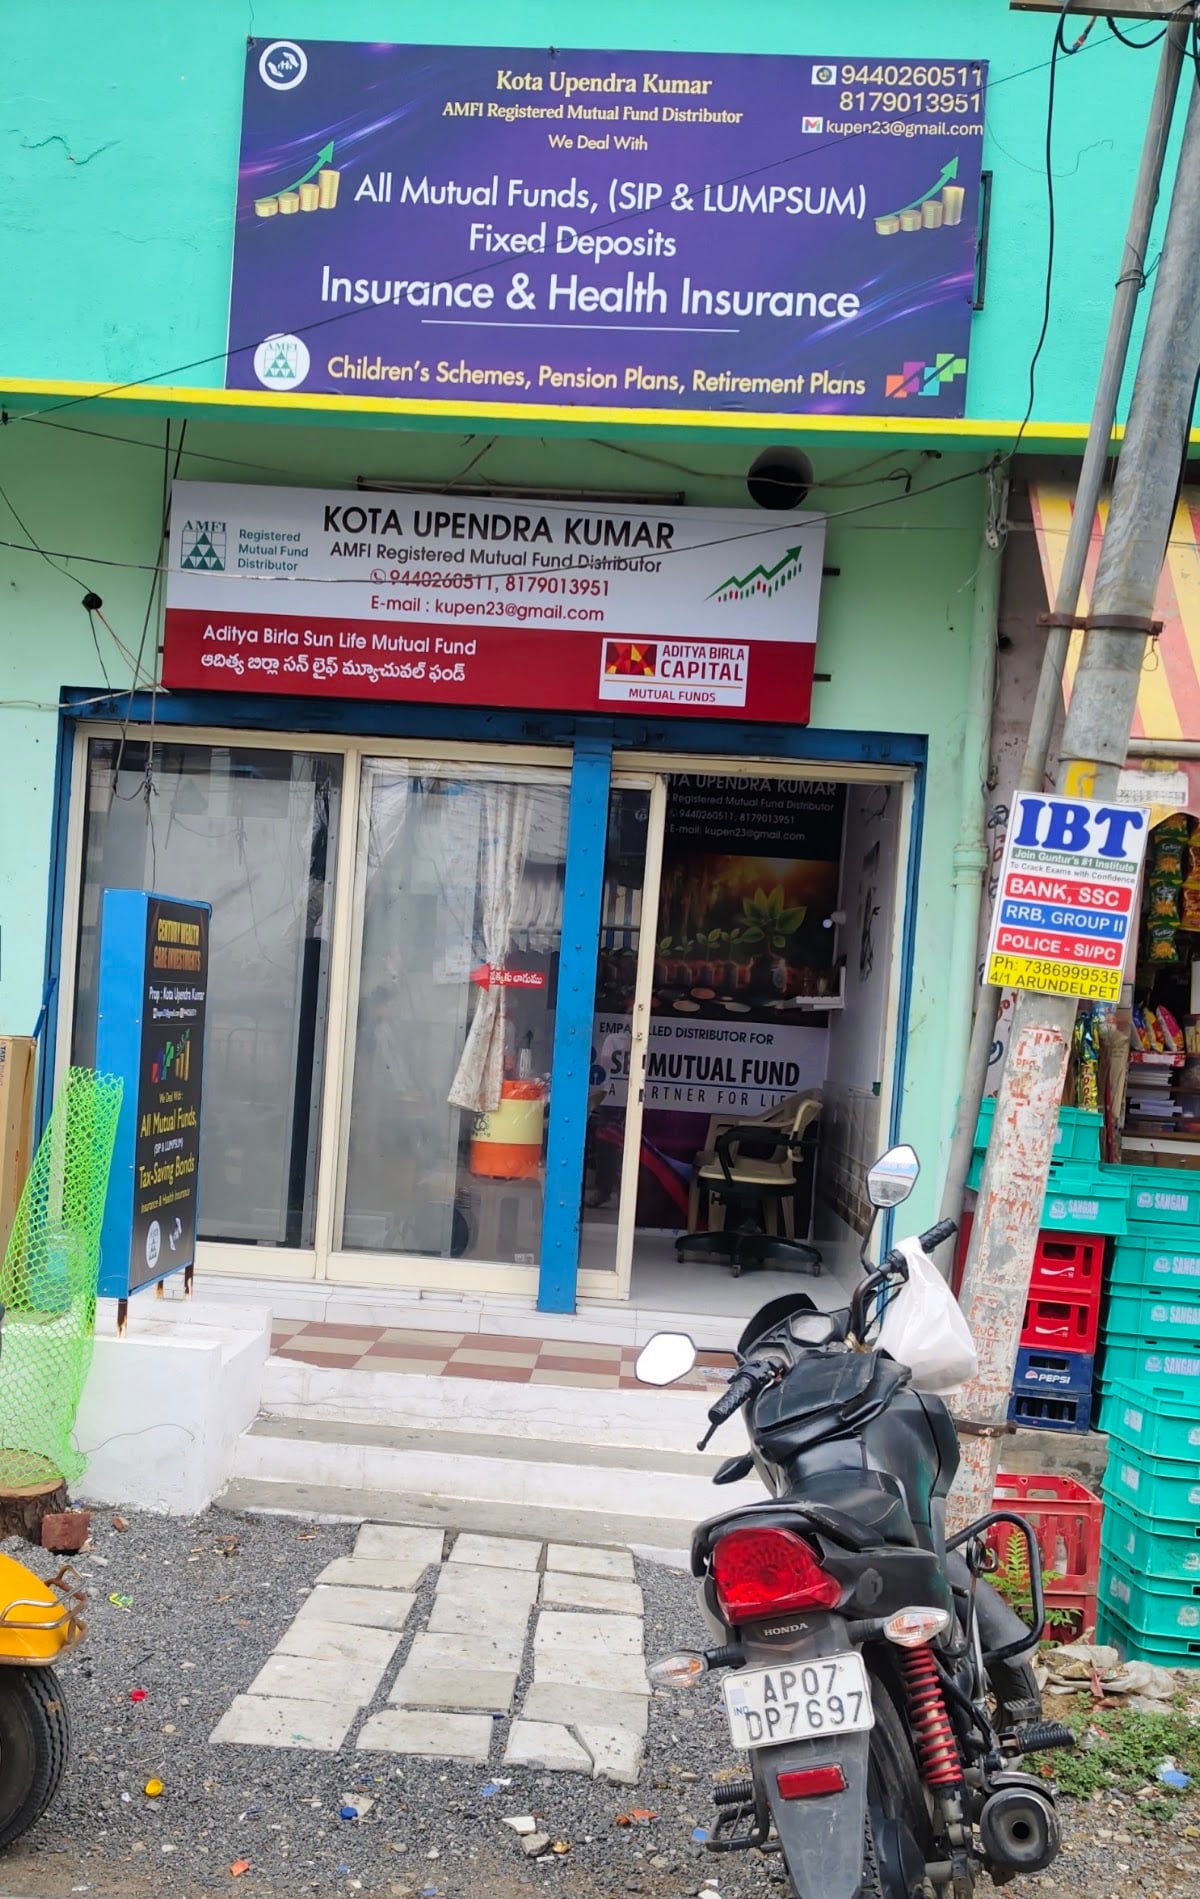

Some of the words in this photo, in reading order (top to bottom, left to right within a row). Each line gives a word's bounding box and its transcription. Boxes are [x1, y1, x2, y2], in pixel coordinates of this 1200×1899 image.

[496, 71, 543, 92] Kota
[550, 72, 636, 97] Upendra
[642, 74, 713, 95] Kumar
[841, 64, 983, 87] 9440260511
[442, 102, 483, 117] AMFI
[487, 103, 563, 122] Registered
[567, 105, 619, 121] Mutual
[623, 107, 660, 121] Fund
[663, 107, 743, 124] Distributor
[839, 92, 981, 113] 8179013951
[826, 119, 984, 137] kupen23@gmail.com
[548, 135, 573, 149] We
[577, 135, 610, 150] Deal
[614, 135, 648, 151] With
[354, 172, 392, 203] All
[400, 175, 498, 207] Mutual
[508, 178, 598, 214] Funds,
[609, 178, 662, 213] (SIP
[671, 183, 694, 212] &
[704, 184, 866, 219] LUMPSUM)
[470, 221, 547, 254] Fixed
[557, 226, 676, 264] Deposits
[321, 266, 494, 309] Insurance
[506, 272, 536, 310] &
[549, 271, 667, 314] Health
[682, 277, 860, 318] Insurance
[436, 361, 532, 390] Schemes,
[538, 366, 618, 389] Pension
[624, 368, 685, 395] Plans,
[693, 370, 804, 395] Retirement
[810, 372, 866, 395] Plans
[184, 520, 227, 532] AMFI
[239, 529, 301, 543] Registered
[323, 505, 402, 535] KOTA
[413, 511, 553, 543] UPENDRA
[564, 517, 675, 550] KUMAR
[238, 544, 277, 556] Mutual
[280, 546, 309, 557] Fund
[330, 541, 371, 559] AMFI
[376, 545, 465, 565] Registered
[470, 548, 527, 567] Mutual
[532, 551, 573, 569] Fund
[577, 554, 662, 573] Distributor
[237, 558, 298, 571] Distributor
[389, 569, 499, 593] 9440260511,
[505, 574, 609, 597] 8179013951
[370, 595, 421, 612] E-mail
[434, 597, 605, 622] kupen23@gmail.com
[203, 624, 259, 646] Aditya
[263, 628, 299, 646] Birla
[303, 630, 334, 647] Sun
[339, 632, 367, 649] Life
[372, 634, 430, 653] Mutual
[435, 638, 477, 656] Fund
[662, 644, 707, 659] ADITYA
[709, 646, 745, 661] BIRLA
[200, 652, 245, 676] ఆదిత్య
[247, 654, 280, 676] బిర్లా
[282, 654, 309, 673] సన్
[312, 656, 339, 680] లైఫ్
[342, 660, 427, 684] మ్యూచువల్
[429, 662, 466, 684] ఫండ్
[660, 660, 744, 682] CAPITAL
[628, 687, 675, 701] MUTUAL
[678, 690, 717, 703] FUNDS
[695, 775, 771, 793] UPENDRA
[777, 779, 837, 796] KUMAR
[672, 793, 723, 805] Registered
[726, 796, 759, 807] Mutual
[761, 798, 784, 809] Fund
[786, 800, 834, 812] Distributor
[1014, 799, 1144, 858] IBT
[1014, 849, 1036, 860] Join
[1081, 857, 1093, 867] #1
[1010, 861, 1019, 870] To
[1021, 863, 1044, 873] Crack
[1045, 866, 1072, 876] Exams
[1073, 869, 1090, 879] with
[1091, 871, 1136, 885] Confidence
[1009, 879, 1073, 904] BANK,
[1078, 887, 1120, 907] SSC
[1005, 905, 1046, 924] RRB,
[1051, 911, 1110, 931] GROUP
[1001, 933, 1061, 954] POLICE
[1073, 943, 1117, 961] SI/PC
[994, 956, 1018, 972] Ph:
[1024, 960, 1119, 985] 7386999535
[990, 971, 1011, 985] 4/1
[1015, 975, 1118, 999] ARUNDELPET
[599, 1022, 672, 1037] EMPALLED
[675, 1028, 746, 1043] DISTRIBUTOR
[749, 1032, 774, 1045] FOR
[648, 1053, 736, 1083] MUTUAL
[741, 1059, 800, 1087] FUND
[608, 1083, 616, 1096] A
[645, 1086, 705, 1103] RTNER
[717, 1090, 749, 1106] FOR
[140, 1114, 152, 1138] All
[153, 1109, 177, 1134] Mutual
[139, 1161, 175, 1189] Tax-Saving
[175, 1152, 195, 1177] Bonds
[1154, 1192, 1189, 1211] SANGAM
[1172, 1256, 1200, 1276] SANGA
[1038, 1374, 1071, 1385] PEPSI
[764, 1622, 809, 1637] HONDA
[763, 1663, 838, 1704] AP07
[745, 1691, 863, 1741] DP7697
